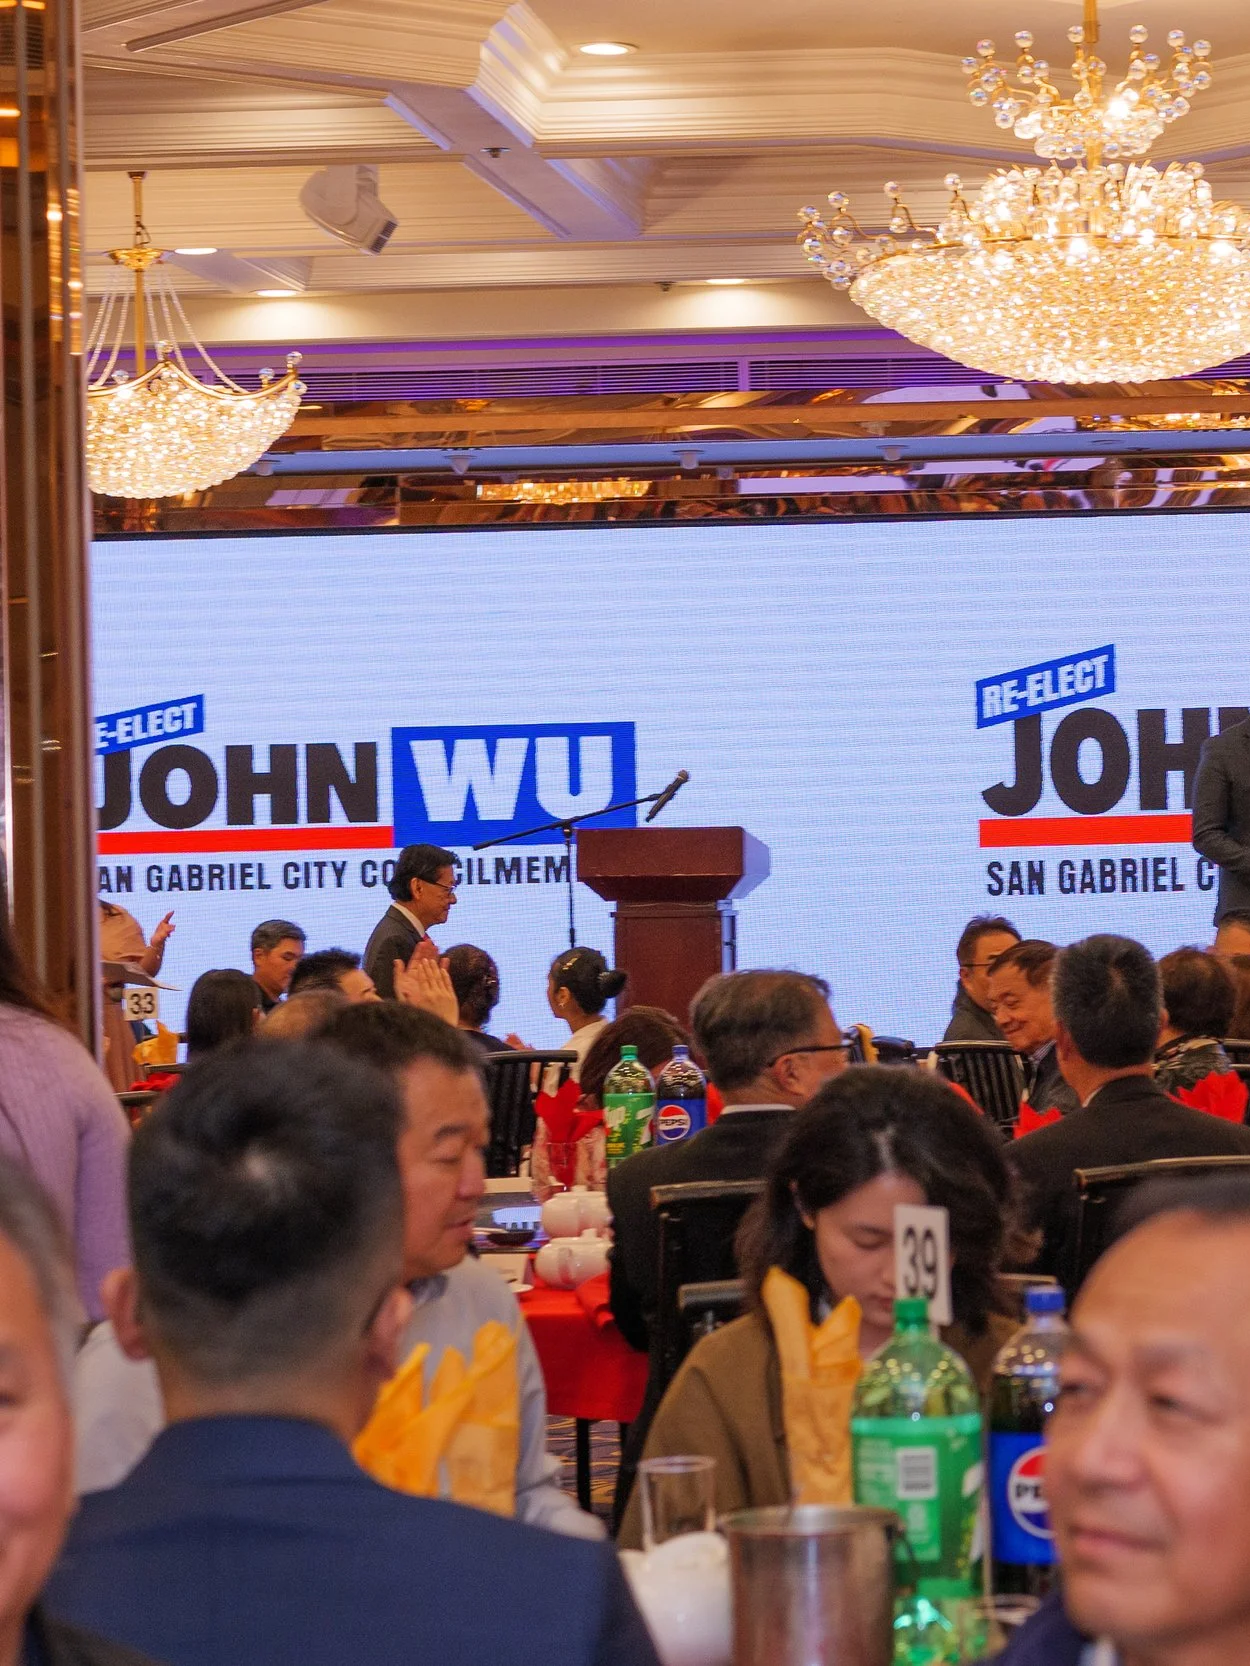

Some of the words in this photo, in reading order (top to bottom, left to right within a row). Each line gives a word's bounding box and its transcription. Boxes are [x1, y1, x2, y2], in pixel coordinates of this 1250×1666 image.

[982, 653, 1109, 719] RE-ELECT
[95, 701, 198, 750] E-ELECT
[97, 741, 378, 831] JOHN
[409, 735, 614, 823] WU
[981, 706, 1250, 817] JOH
[98, 863, 133, 893] AN
[146, 861, 271, 892] GABRIEL
[283, 859, 348, 890] CITY
[987, 860, 1045, 896] SAN
[1058, 857, 1184, 895] GABRIEL
[130, 992, 155, 1015] 33
[903, 1226, 938, 1299] 39
